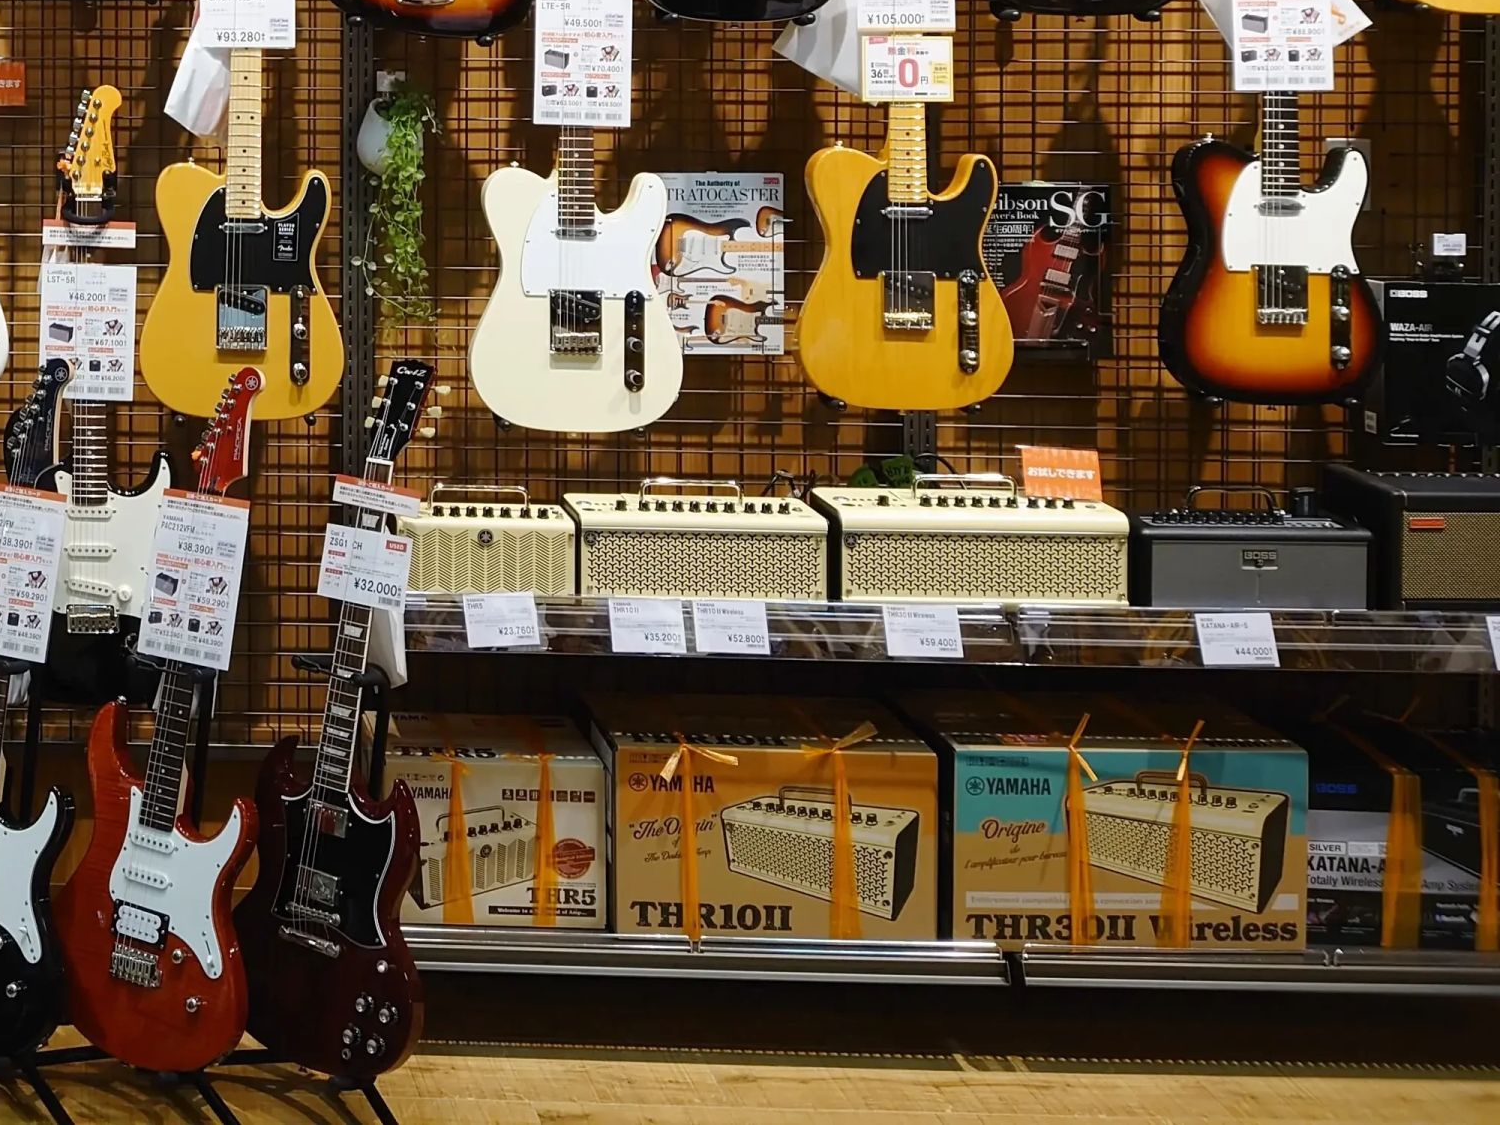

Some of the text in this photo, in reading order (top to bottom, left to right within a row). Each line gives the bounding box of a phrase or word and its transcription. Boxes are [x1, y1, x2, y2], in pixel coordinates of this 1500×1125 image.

[542, 3, 570, 11] LTE-5R
[564, 19, 598, 28] ¥49,500
[867, 13, 922, 25] ¥105,000
[216, 31, 262, 43] ¥93,280
[898, 58, 920, 88] 0
[695, 179, 706, 187] The
[706, 179, 734, 187] Authority
[667, 187, 780, 202] TRATOCASTER
[994, 191, 1110, 228] ibson SG
[1016, 211, 1040, 220] Book
[69, 292, 104, 302] ¥46,200
[178, 541, 210, 555] ¥38,390
[388, 542, 405, 551] USED
[1244, 551, 1276, 559] BOSS
[354, 577, 399, 597] ¥32,000
[649, 774, 714, 793] YAMHA
[986, 777, 1052, 795] YAMAHA
[982, 819, 1046, 843] Origine
[1309, 843, 1342, 853] SILVER
[1307, 855, 1387, 873] KATANA-A
[526, 887, 597, 906] THR5
[629, 901, 793, 931] THR10II
[966, 913, 1136, 941] THR30II
